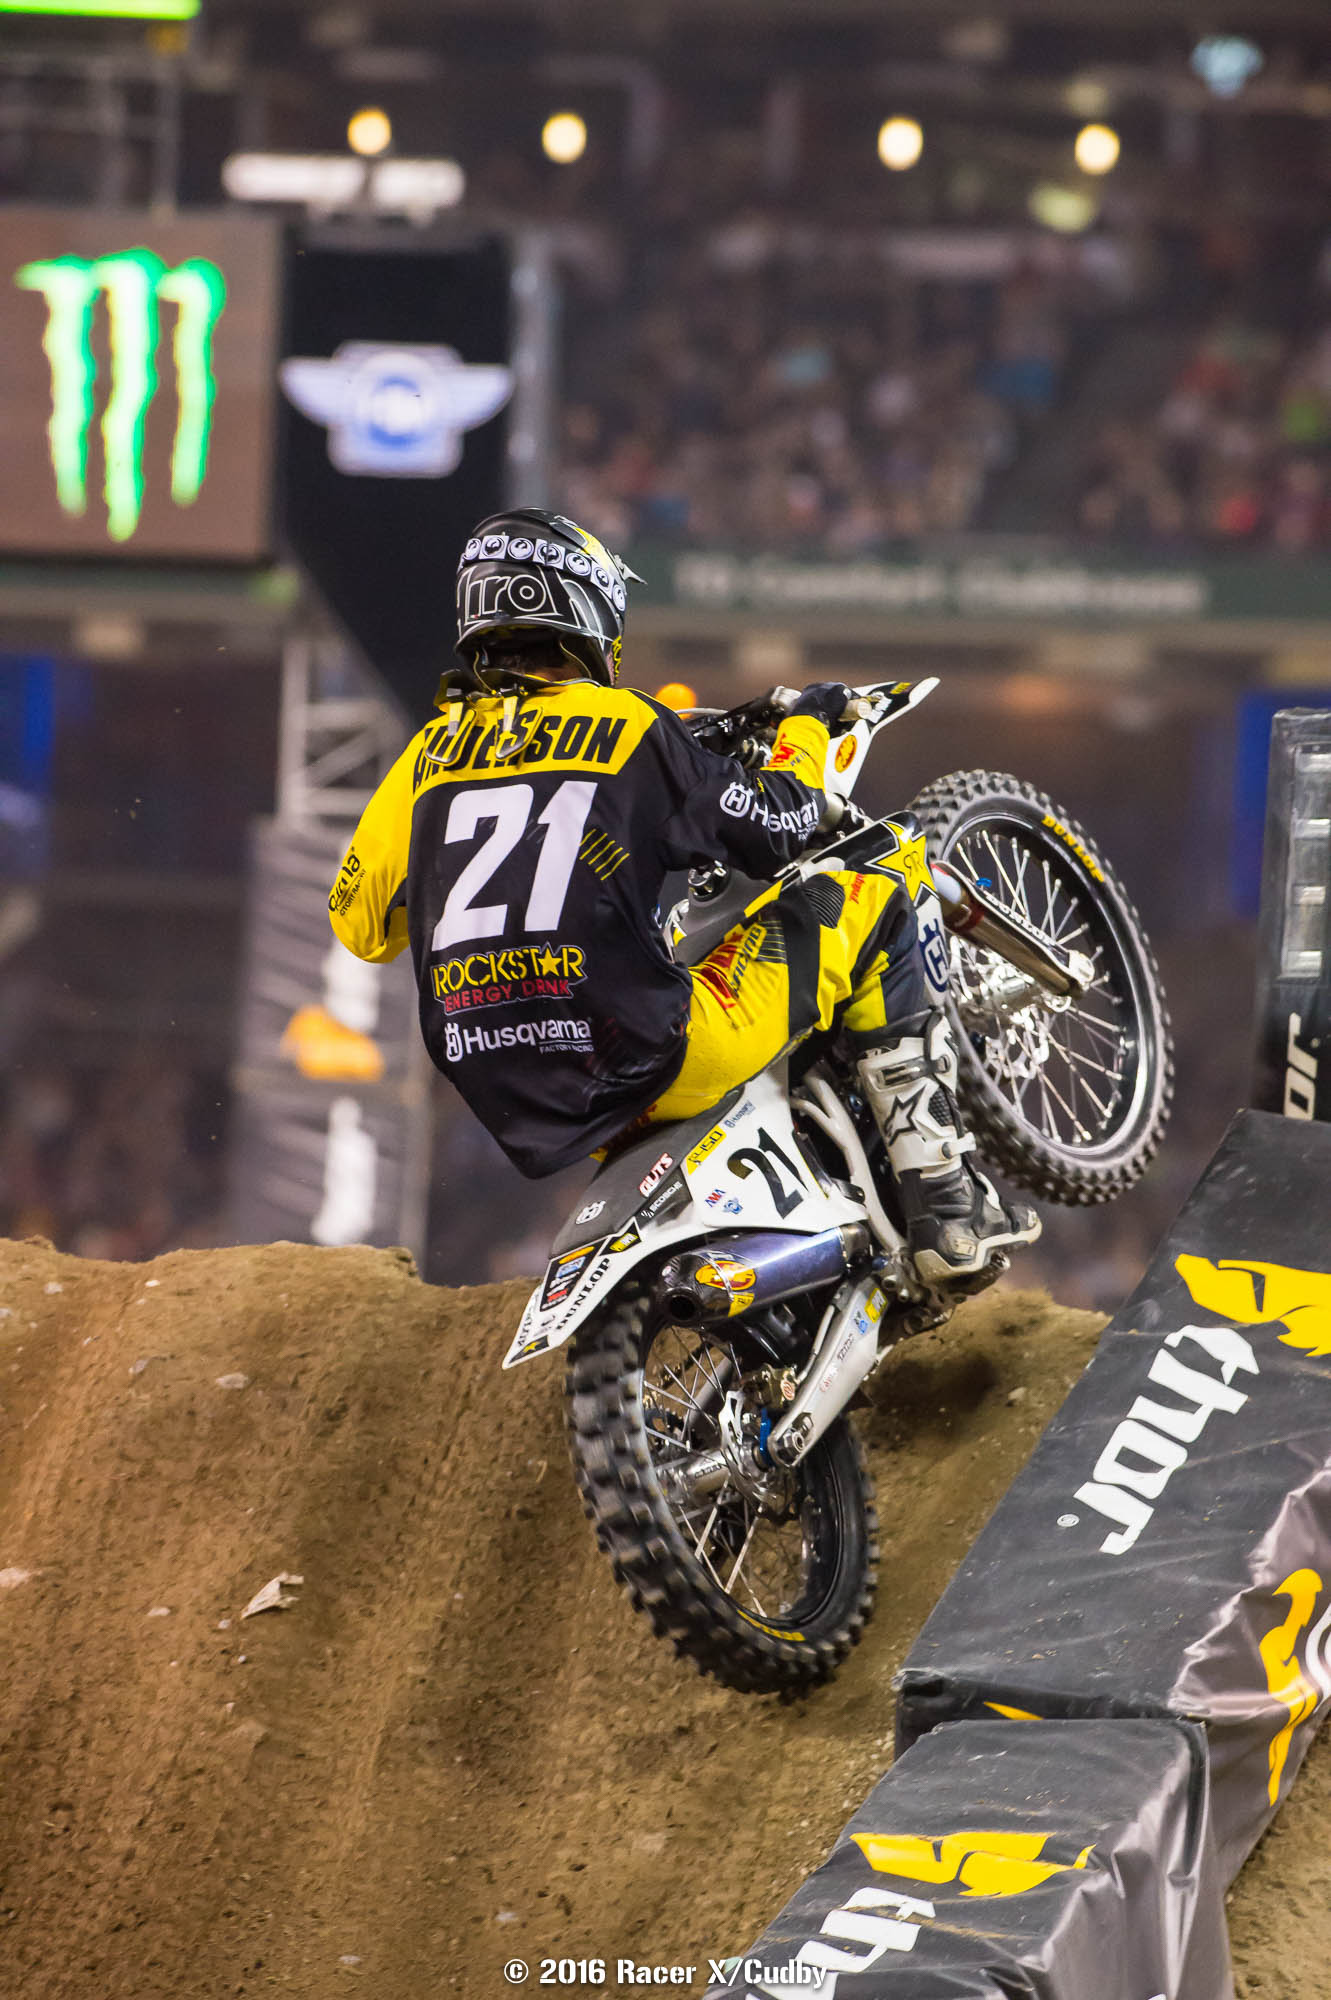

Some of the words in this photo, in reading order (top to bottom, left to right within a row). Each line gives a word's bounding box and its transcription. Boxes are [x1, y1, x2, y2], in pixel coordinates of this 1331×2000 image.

[432, 780, 598, 952] 21
[444, 983, 512, 1012] ENERGY
[521, 978, 573, 998] DRNK
[637, 1151, 674, 1198] GUTS
[727, 1127, 809, 1219] 21
[555, 1257, 611, 1331] DUNLOP
[745, 1887, 936, 2000] tho
